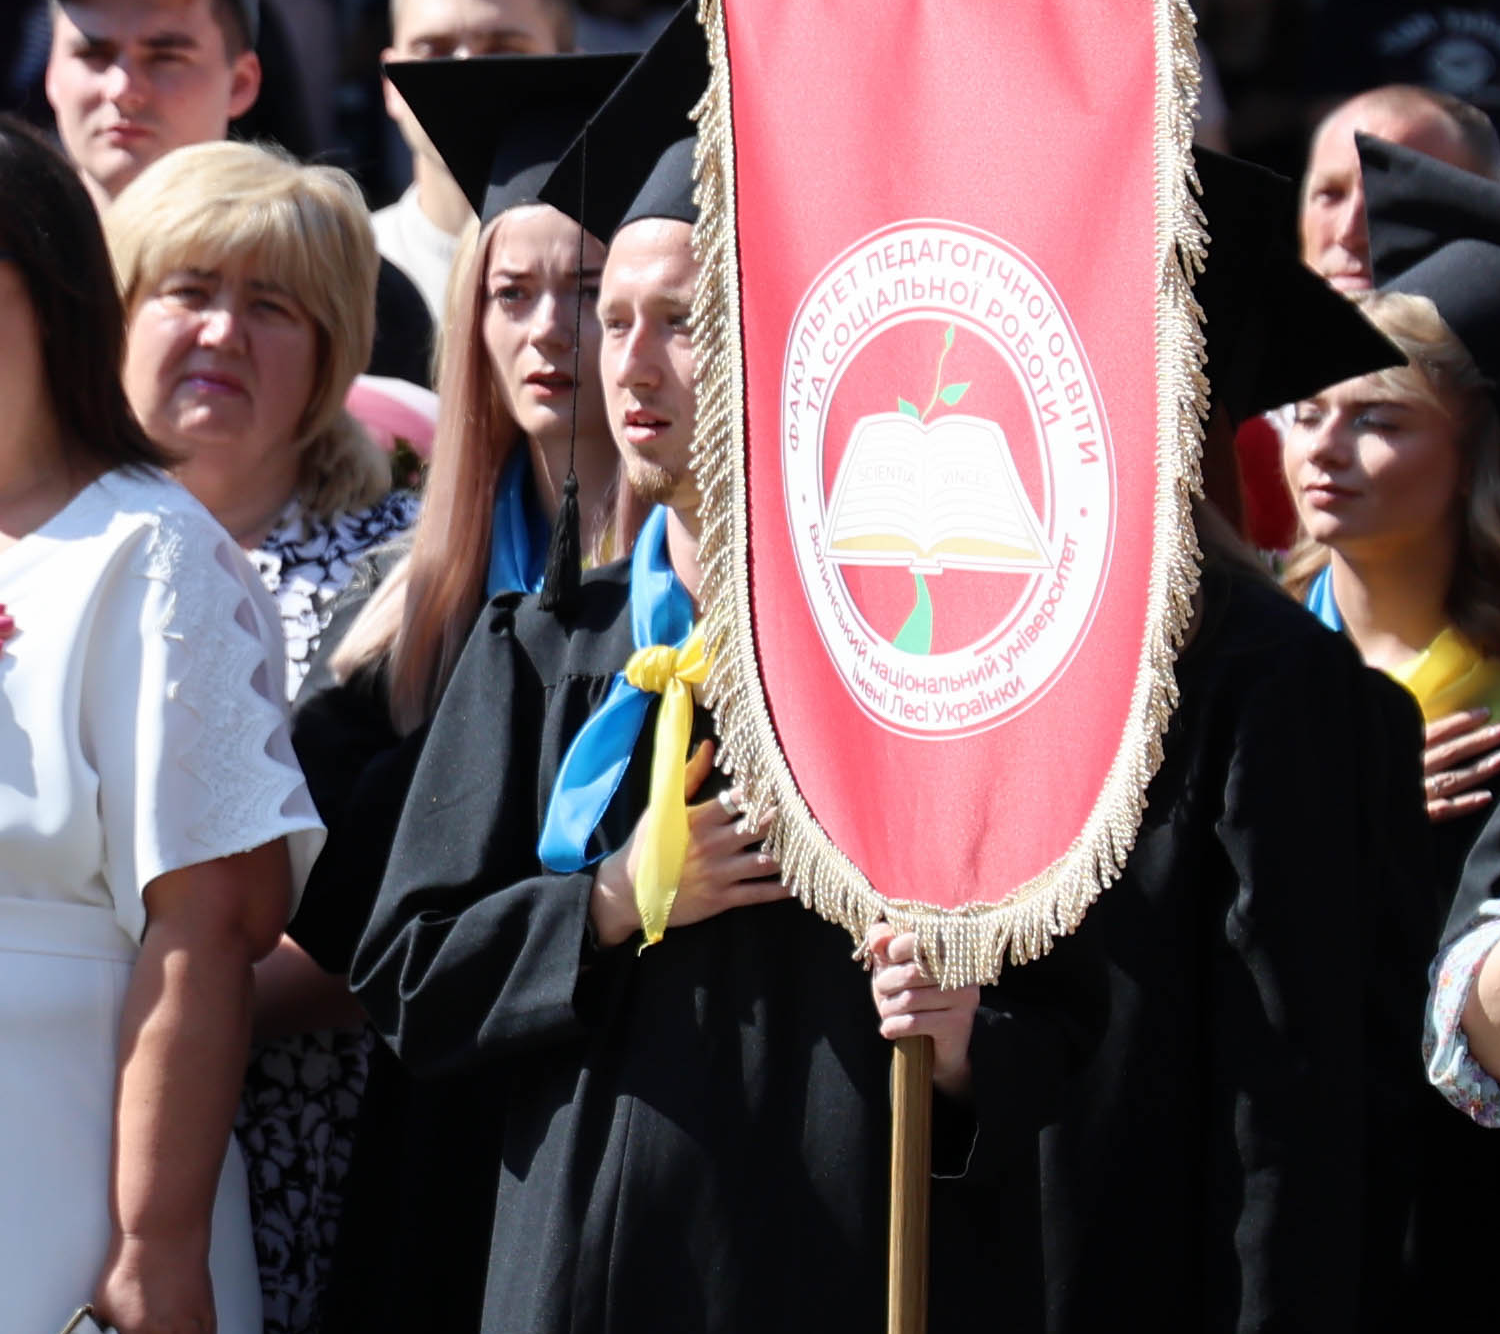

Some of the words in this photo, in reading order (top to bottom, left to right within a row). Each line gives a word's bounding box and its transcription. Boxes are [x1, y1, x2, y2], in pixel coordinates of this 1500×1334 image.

[788, 267, 859, 452] ФАКУЛЬТЕТ
[865, 238, 1057, 330] ПЕДАГОГІЧНОЇ
[1048, 332, 1100, 465] ОСВІТИ
[807, 375, 827, 414] ТА
[822, 277, 983, 366] СОЦІАЛЬНОЇ
[984, 298, 1062, 426] РОБОТИ
[809, 523, 867, 662] Волинський
[870, 657, 1000, 695] національний
[999, 532, 1079, 672] університет
[852, 665, 887, 709] імені
[890, 695, 929, 723] Лесі
[935, 675, 1025, 725] Українки
